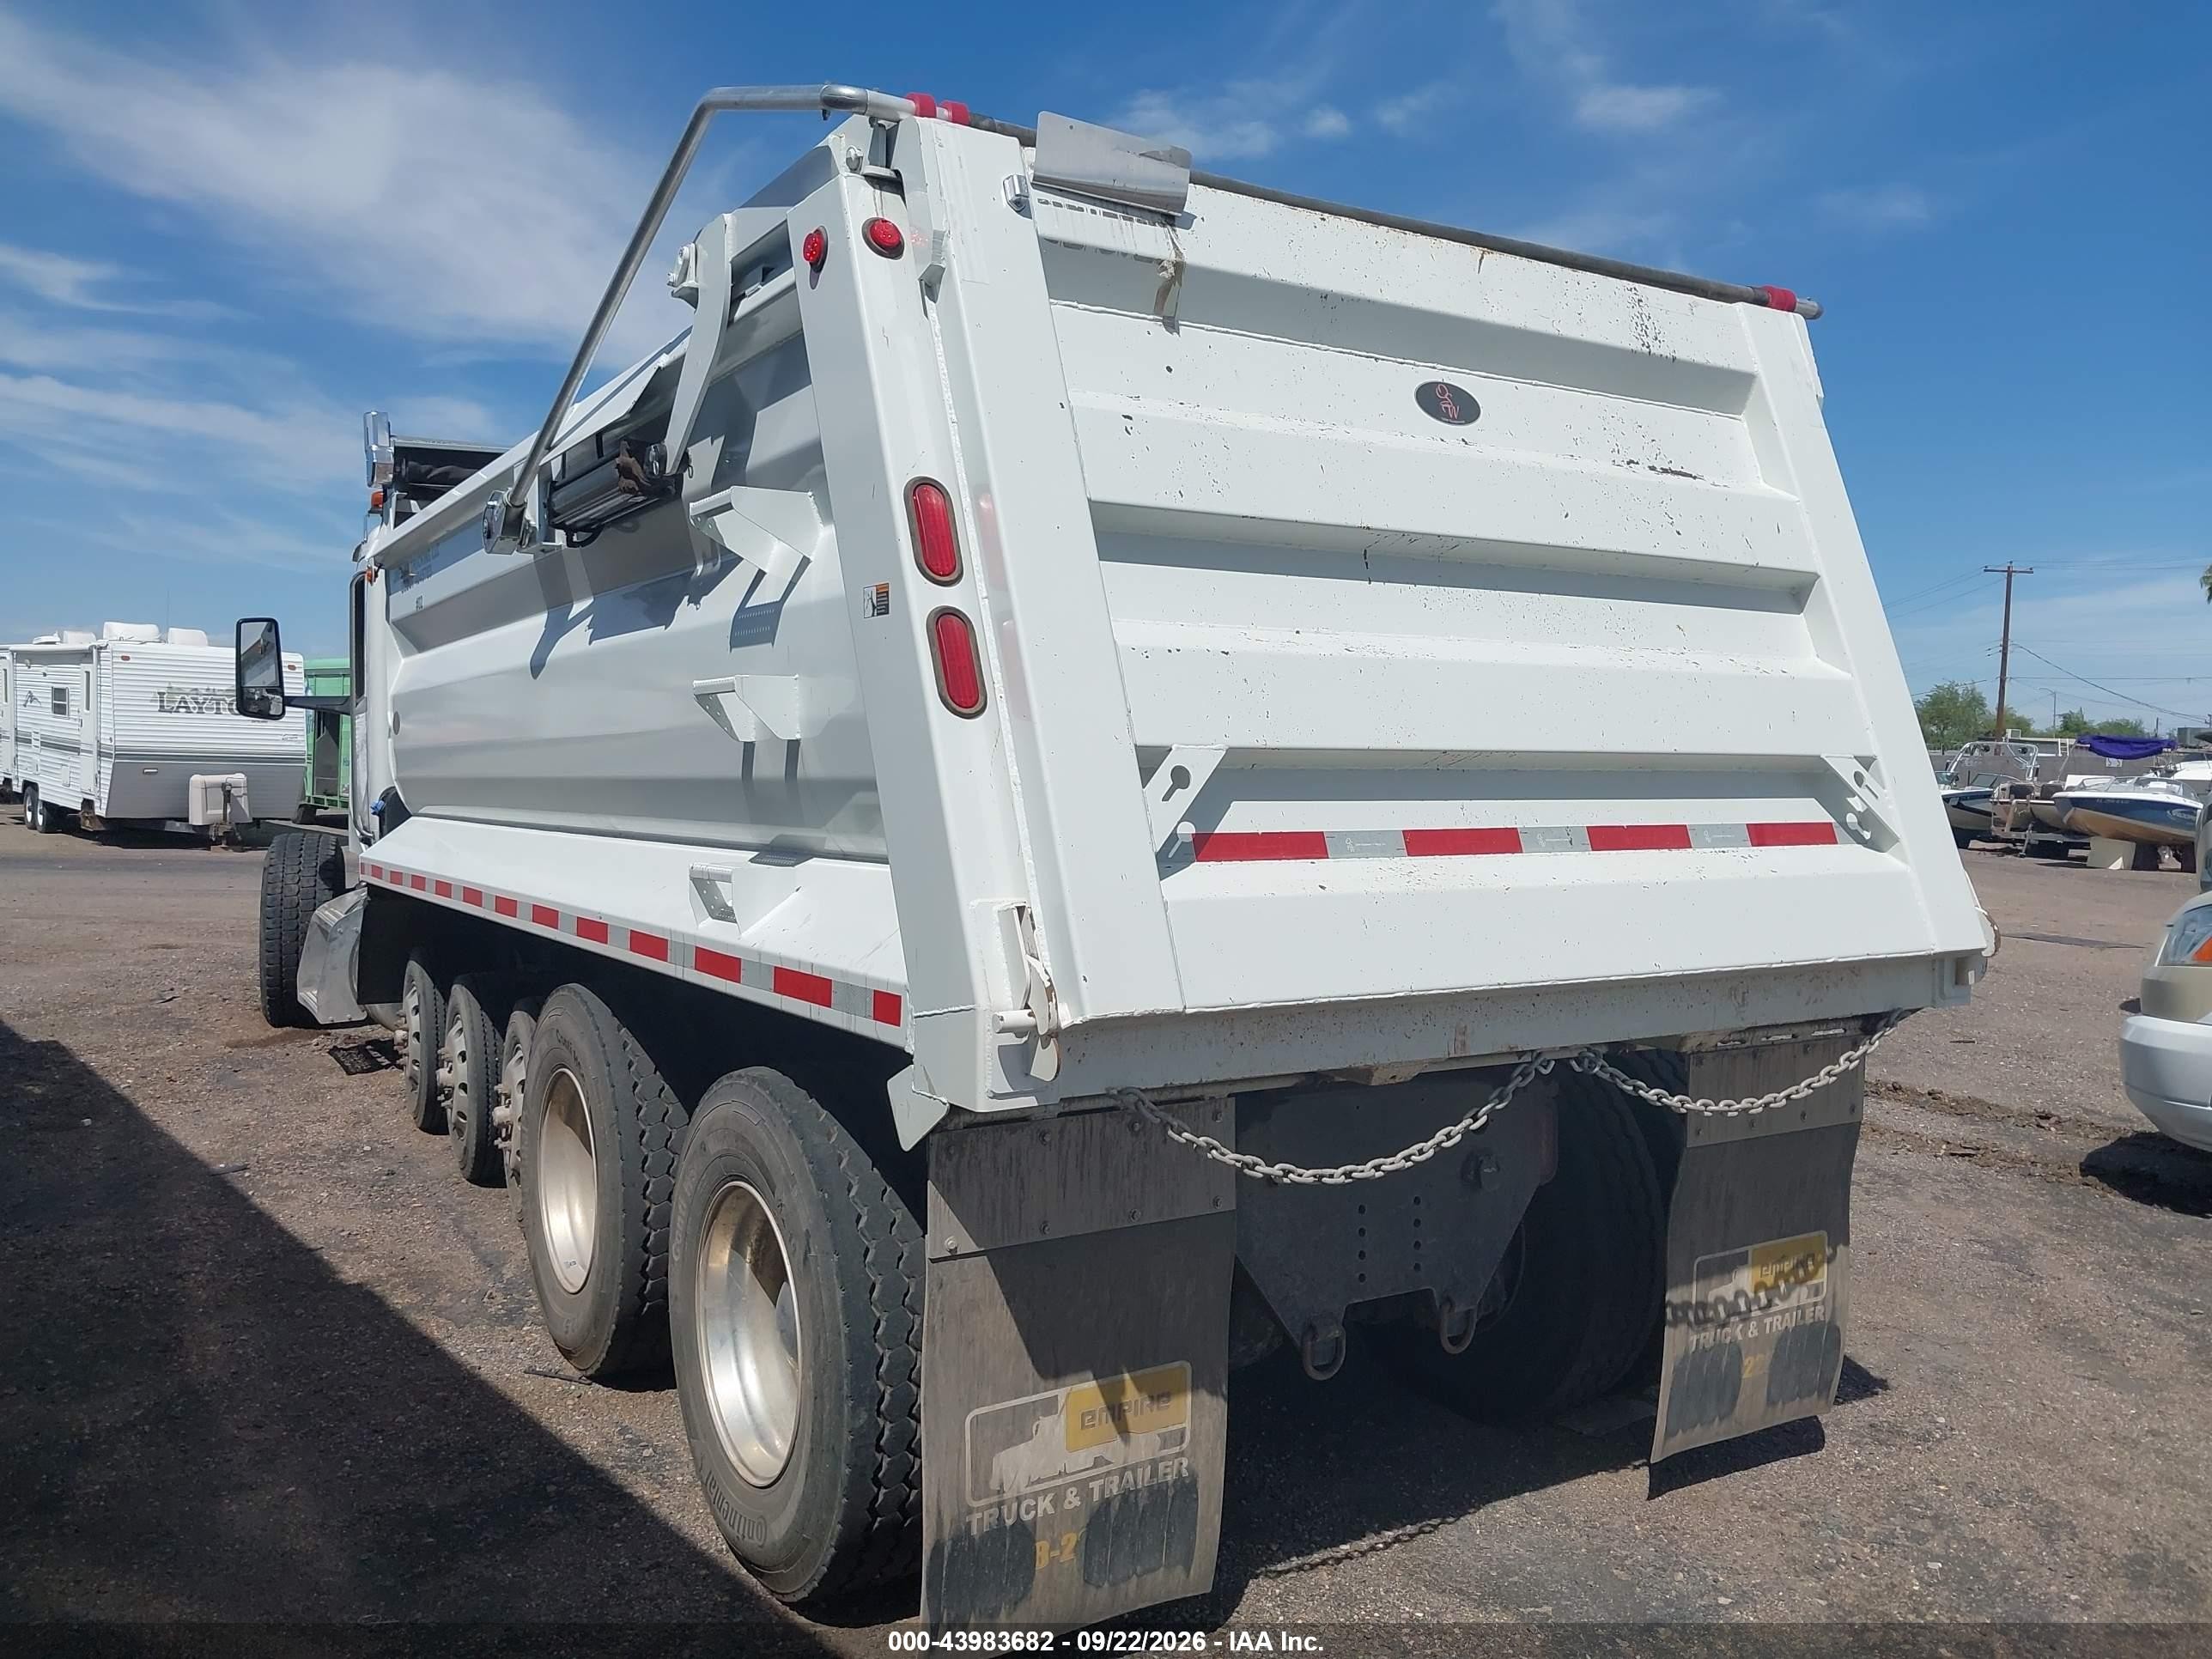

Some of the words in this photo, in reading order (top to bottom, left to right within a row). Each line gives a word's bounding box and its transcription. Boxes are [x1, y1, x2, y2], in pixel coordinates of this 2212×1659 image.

[1689, 1323, 1744, 1354] TRUCK
[1748, 1321, 1759, 1340] &
[1764, 1304, 1825, 1335] TRAILER
[704, 1470, 769, 1549] Continental
[966, 1492, 1055, 1536] TRUCK
[1063, 1486, 1081, 1510] &
[1089, 1456, 1189, 1503] TRAILER
